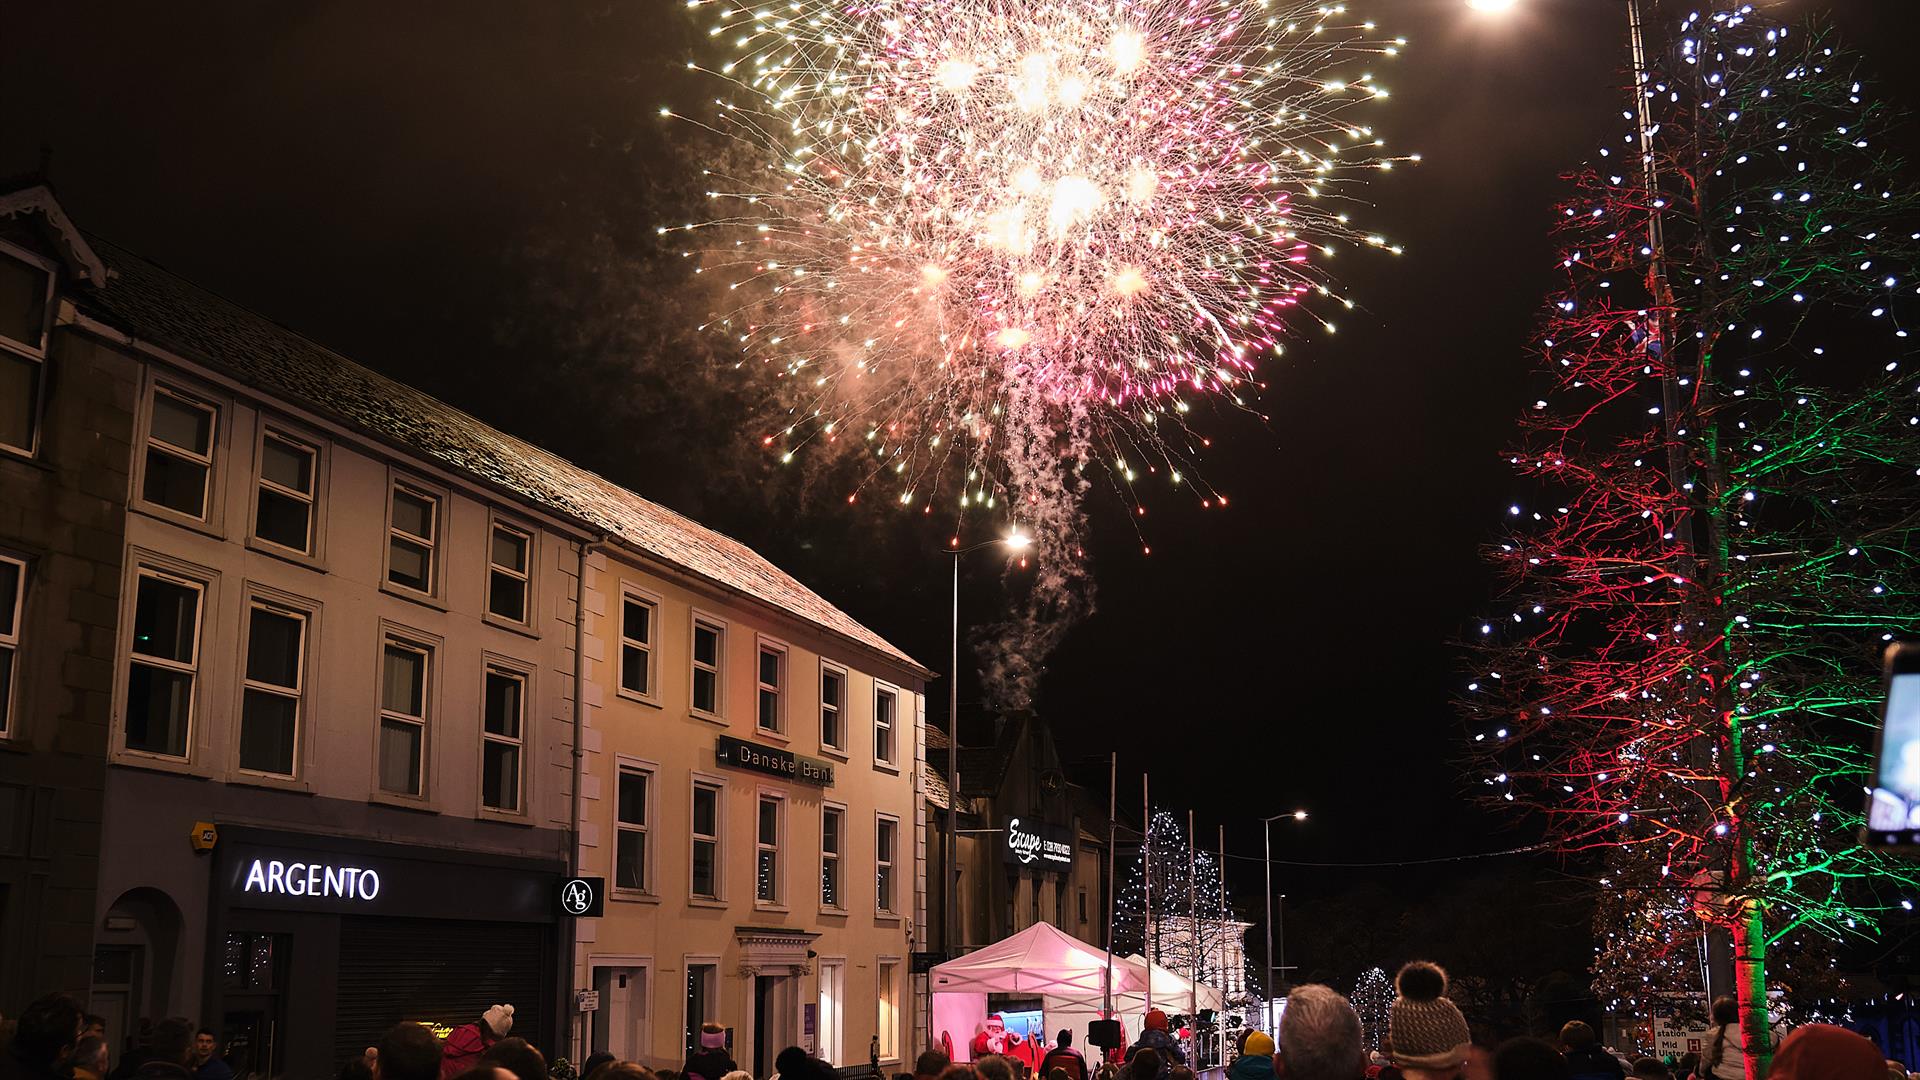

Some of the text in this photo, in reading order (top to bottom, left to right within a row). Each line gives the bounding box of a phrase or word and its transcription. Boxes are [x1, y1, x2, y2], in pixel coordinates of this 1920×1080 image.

[740, 745, 834, 781] Danske Bank
[1009, 818, 1042, 864] Escape
[244, 859, 380, 900] ARGENTO
[566, 883, 587, 910] Ag
[1662, 1041, 1678, 1049] Mid
